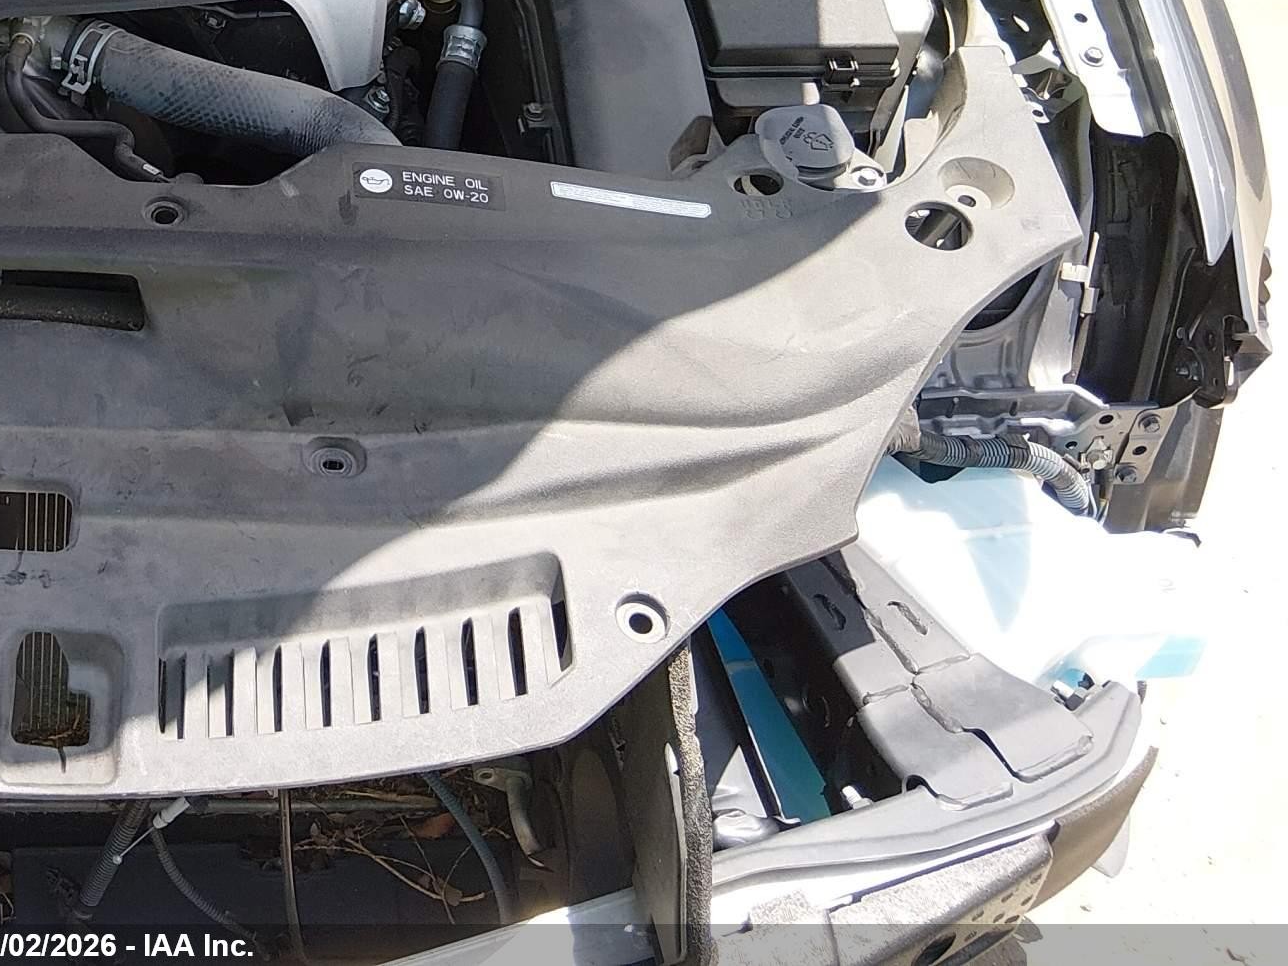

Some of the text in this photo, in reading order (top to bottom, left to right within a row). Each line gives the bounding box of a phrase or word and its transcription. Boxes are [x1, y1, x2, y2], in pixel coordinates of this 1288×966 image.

[402, 171, 489, 191] ENGINE OIL
[404, 184, 489, 203] SAE 0W-20
